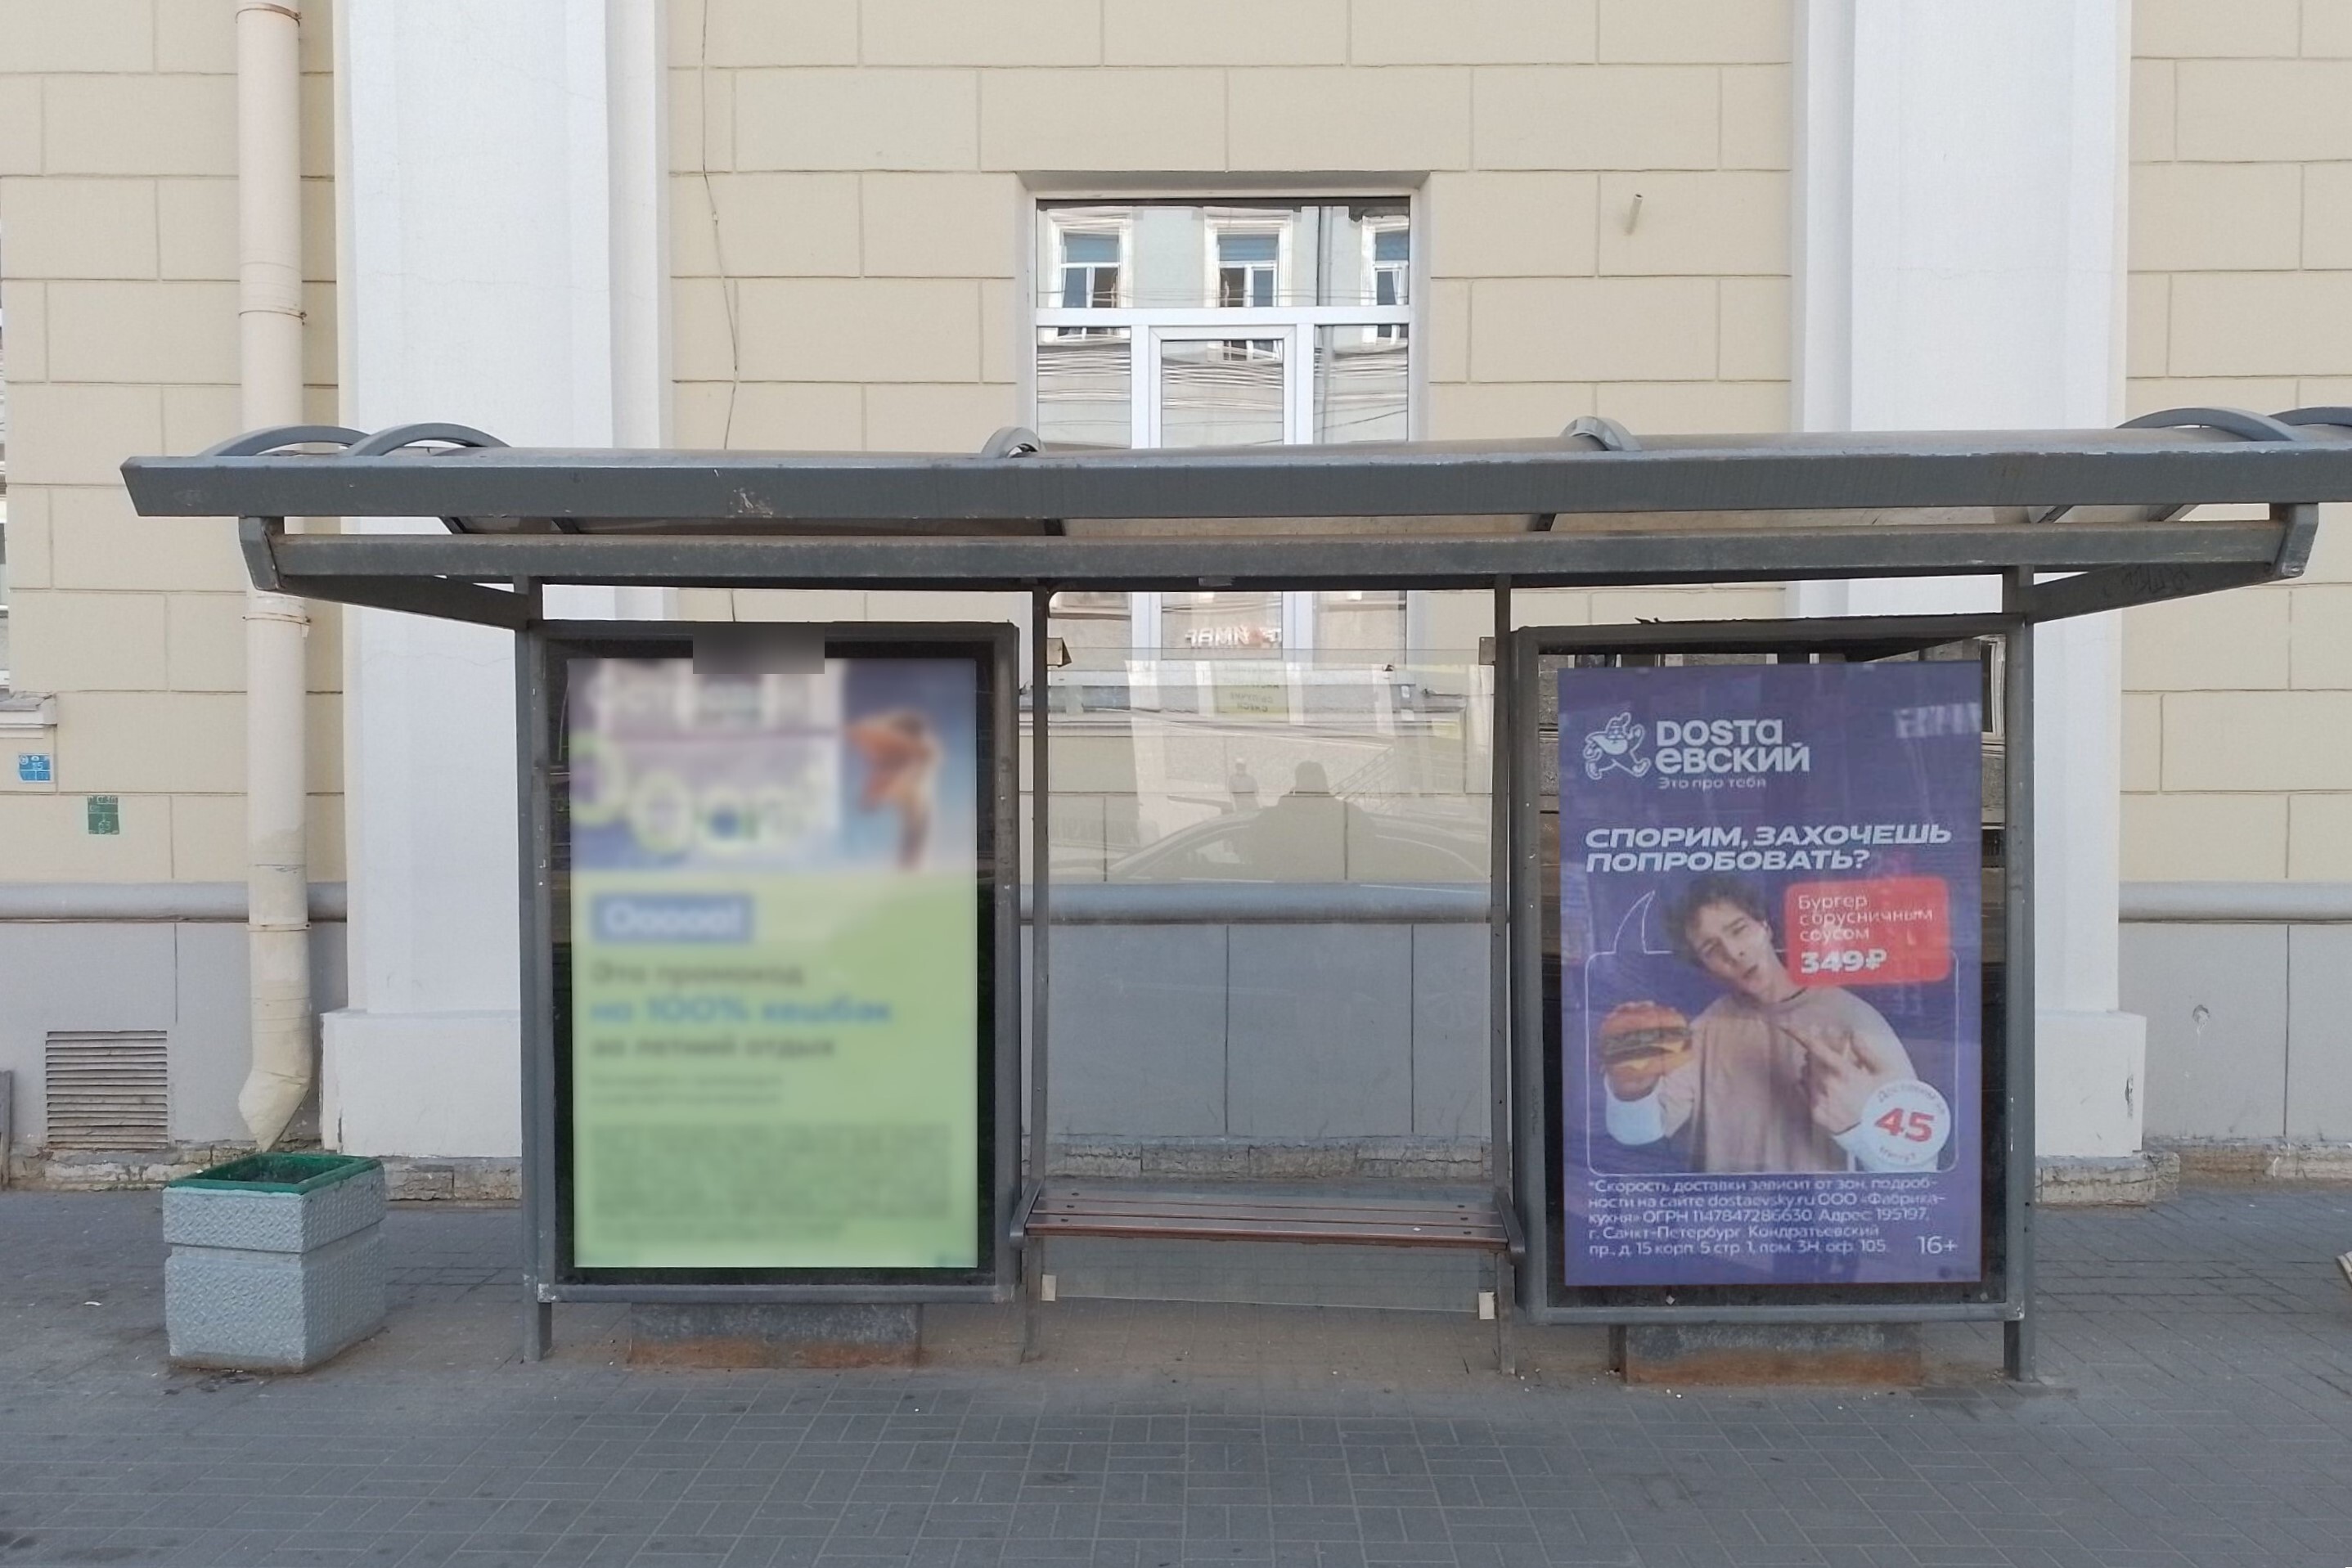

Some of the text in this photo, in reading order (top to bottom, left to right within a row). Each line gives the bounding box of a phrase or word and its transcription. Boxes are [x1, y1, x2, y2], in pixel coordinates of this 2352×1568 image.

[1693, 779, 1724, 792] про
[1729, 776, 1767, 789] тебя
[1585, 824, 1952, 849] СПОРИМ, ЗАХОЧЕШЬ
[1585, 850, 1871, 873] ПОПРОБОВАТЬ?
[1798, 895, 1869, 912] Бургер
[1811, 910, 1933, 929] брусничным
[1800, 928, 1870, 944] соусом
[1874, 1107, 1935, 1142] 45
[1672, 1180, 1747, 1193] доставки
[1750, 1180, 1810, 1191] зависит
[1815, 1180, 1833, 1190] от
[1871, 1178, 1938, 1191] подроб-
[1589, 1197, 1635, 1208] ности
[1637, 1197, 1657, 1207] на
[1659, 1196, 1704, 1207] сайте
[1818, 1193, 1857, 1206] ООО
[1642, 1210, 1689, 1223] ОГРН
[1636, 1242, 1653, 1255] 15
[1700, 1241, 1711, 1254] 5
[1918, 1235, 1959, 1254] 16+
